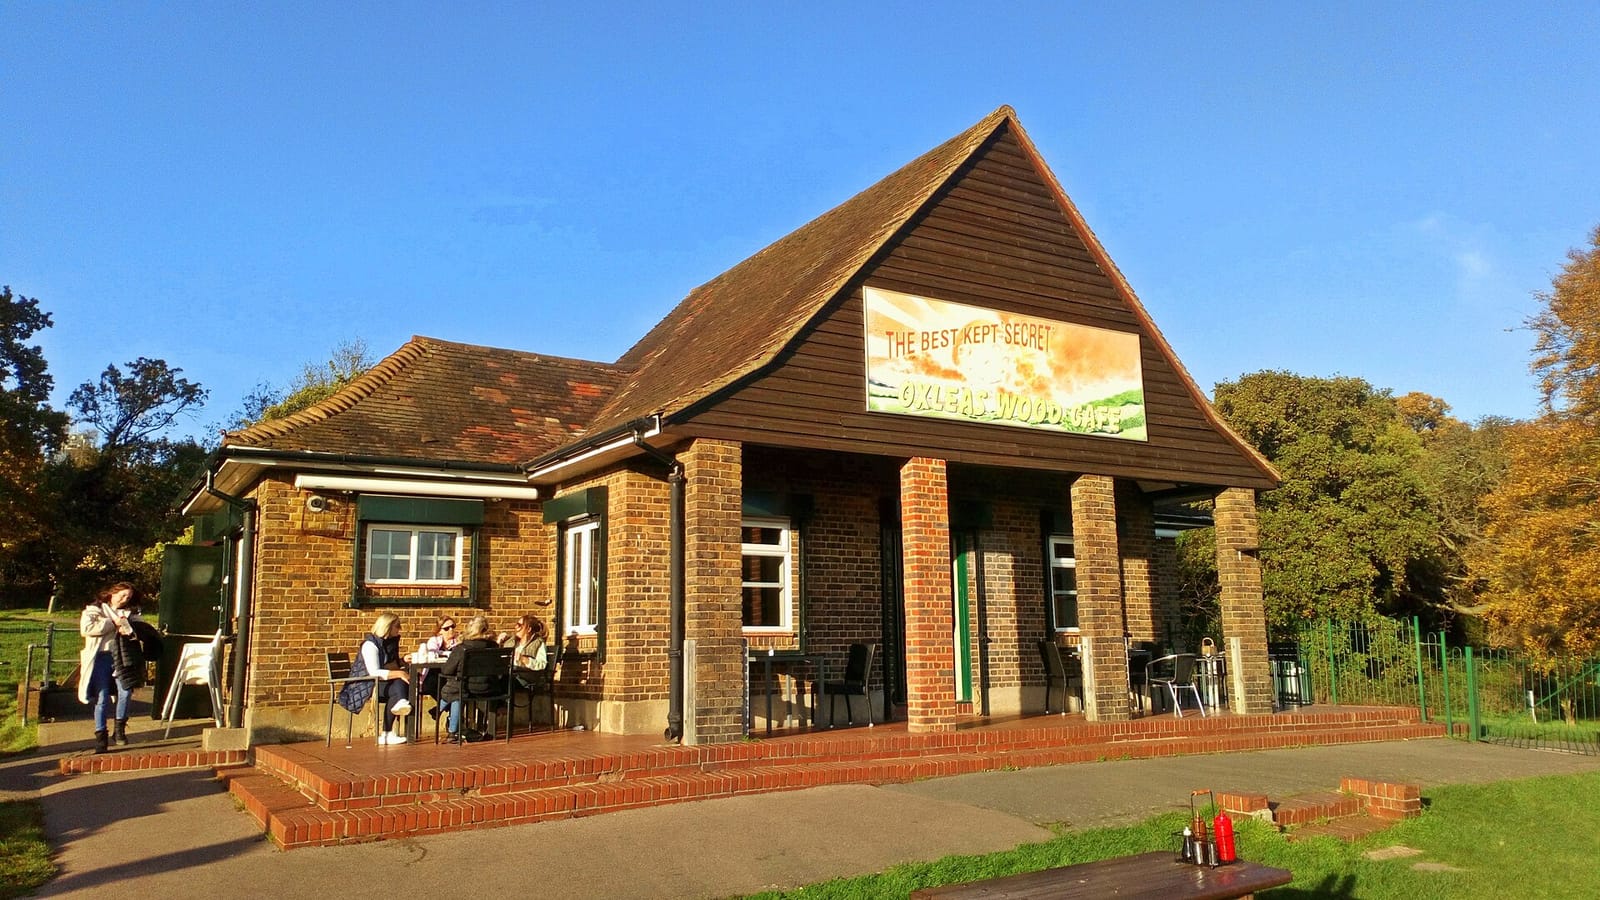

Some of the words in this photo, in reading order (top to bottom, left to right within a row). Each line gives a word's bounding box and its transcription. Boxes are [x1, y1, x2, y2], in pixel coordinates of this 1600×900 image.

[885, 331, 915, 359] THE
[921, 328, 958, 351] BEST
[963, 324, 998, 344] KEPT
[901, 381, 989, 416] OXLEAS
[997, 393, 1062, 424] WOOD
[1071, 404, 1122, 434] CAFE
